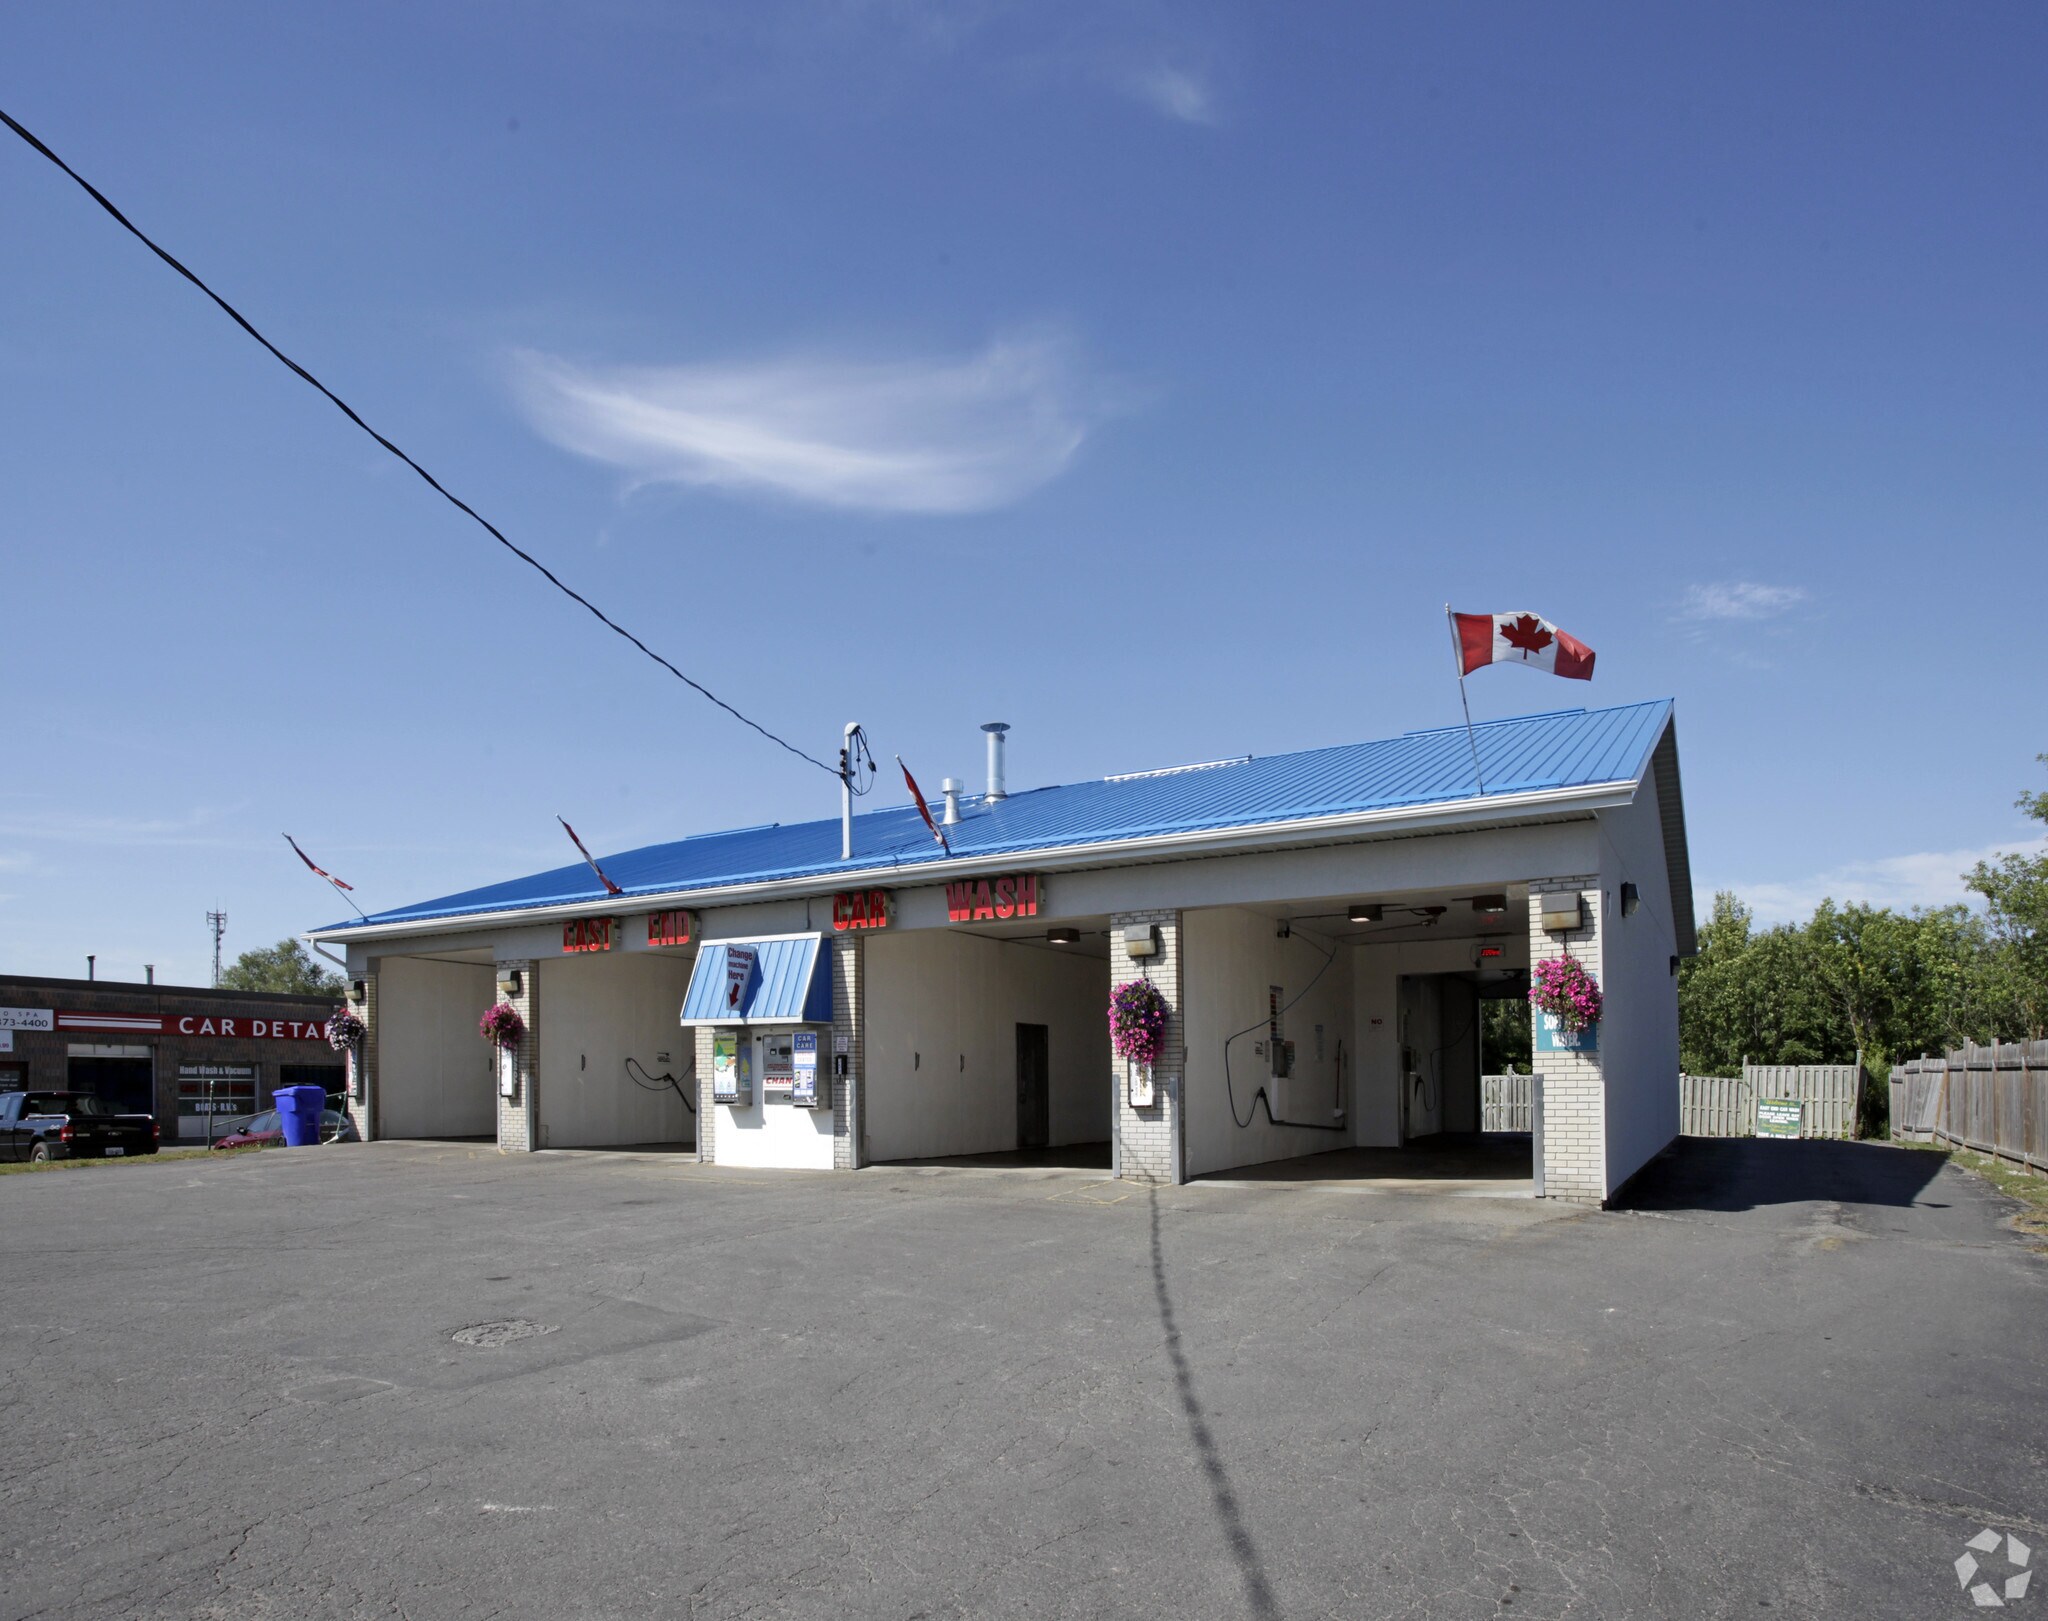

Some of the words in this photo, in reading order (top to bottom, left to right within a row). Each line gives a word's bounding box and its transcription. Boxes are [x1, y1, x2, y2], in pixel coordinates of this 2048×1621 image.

[563, 917, 613, 953] EAST
[647, 911, 691, 947] END
[832, 889, 887, 932] CAR
[945, 875, 1038, 922] WASH
[727, 946, 753, 961] Change
[728, 970, 745, 981] Here
[178, 1016, 236, 1036] CAR
[180, 1065, 198, 1075] Hand
[199, 1065, 218, 1075] Wash
[224, 1065, 252, 1075] Vacuum
